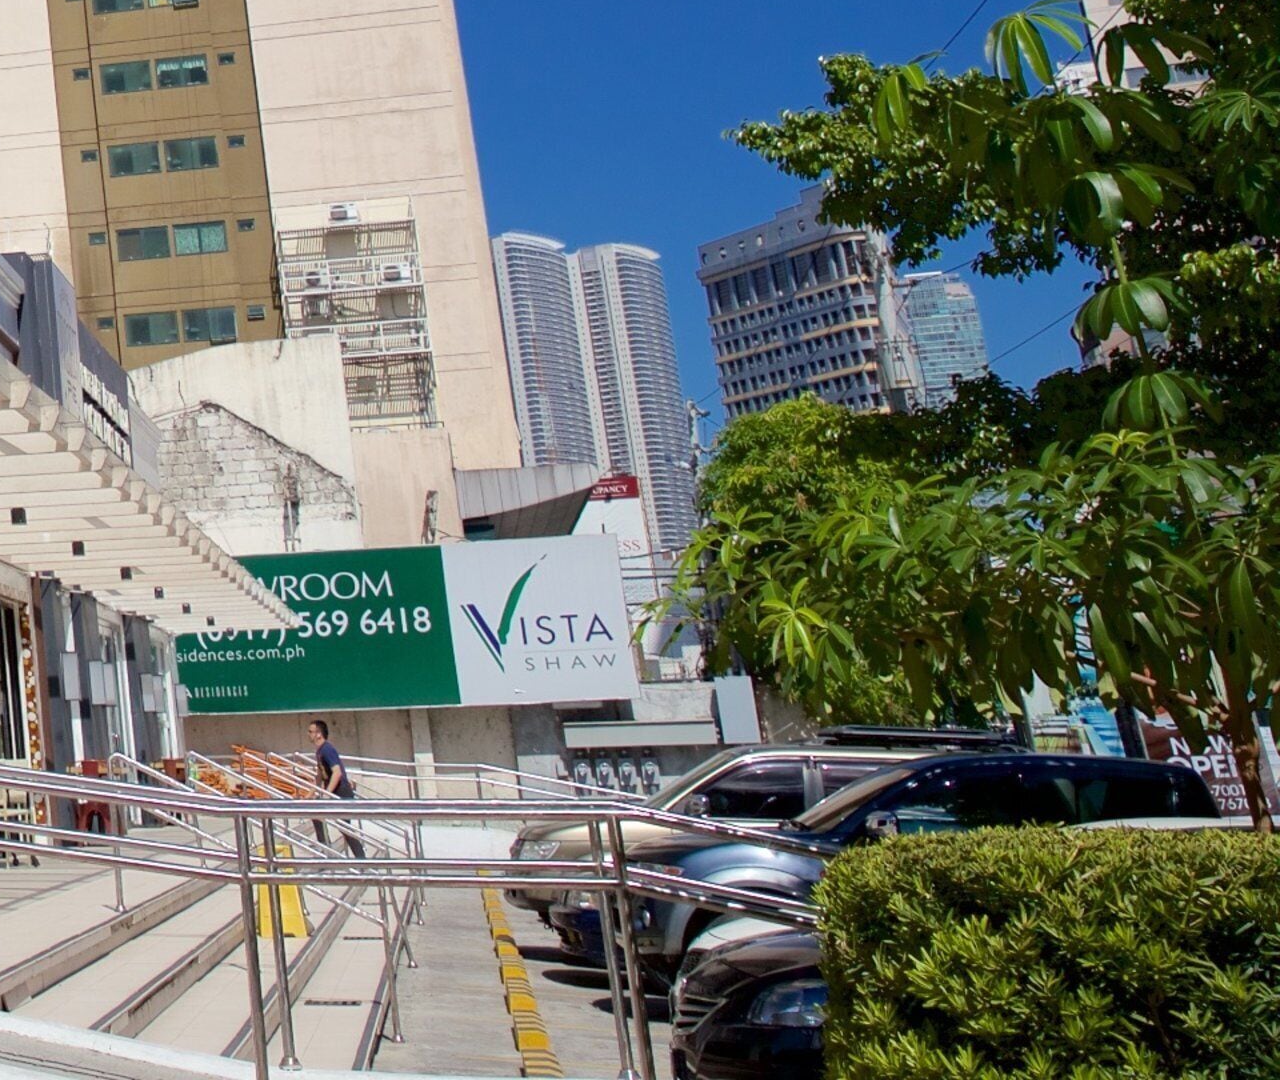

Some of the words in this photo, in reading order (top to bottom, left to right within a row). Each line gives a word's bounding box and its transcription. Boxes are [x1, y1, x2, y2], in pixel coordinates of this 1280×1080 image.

[297, 609, 349, 638] 569
[359, 606, 432, 636] 6418
[460, 554, 614, 673] VISTA
[524, 653, 616, 671] SHAW
